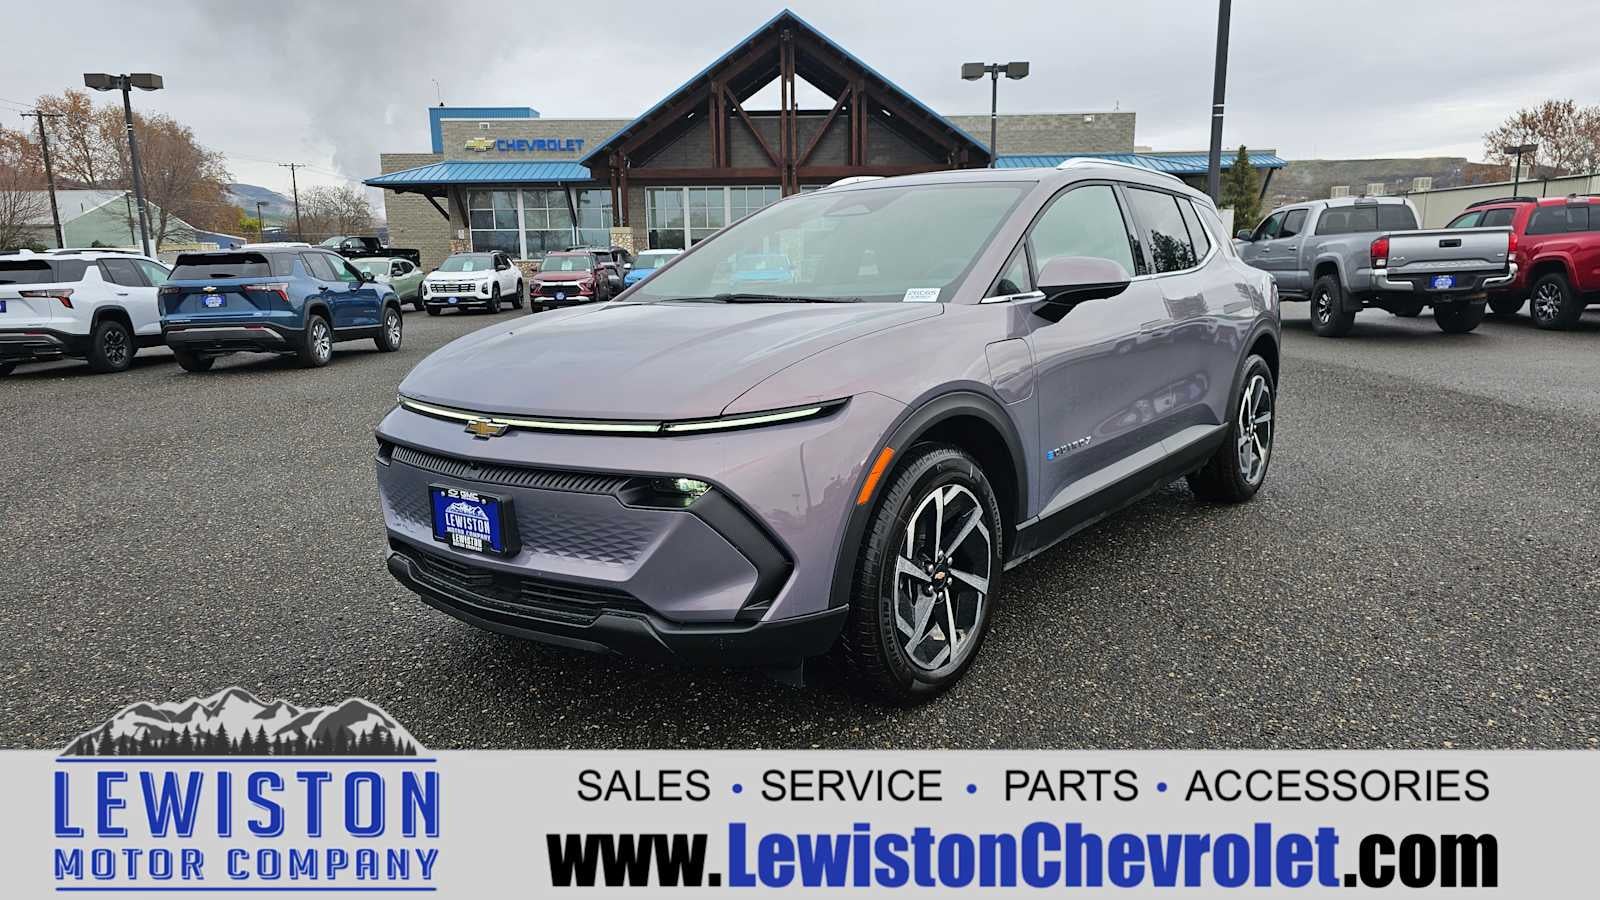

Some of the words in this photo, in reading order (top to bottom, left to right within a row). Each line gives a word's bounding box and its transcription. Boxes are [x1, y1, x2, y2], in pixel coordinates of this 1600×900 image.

[496, 138, 584, 152] CHEVROLET
[445, 513, 491, 535] LEWISTON
[884, 601, 904, 665] MICHELIN
